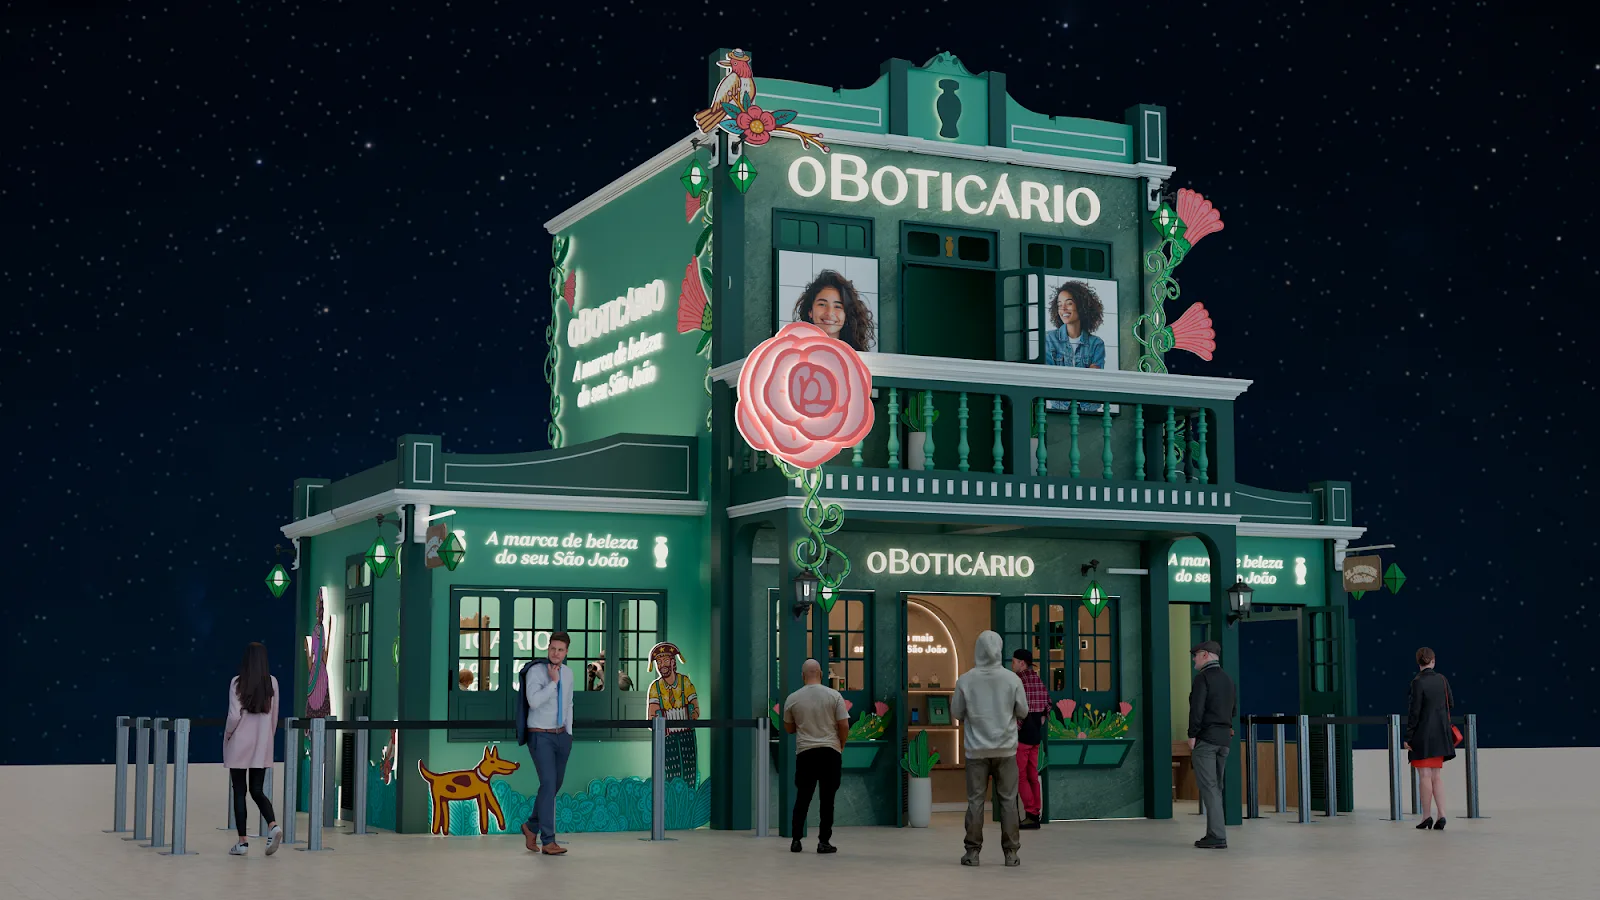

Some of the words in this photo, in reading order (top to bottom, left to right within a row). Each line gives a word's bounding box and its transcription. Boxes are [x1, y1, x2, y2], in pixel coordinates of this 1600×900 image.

[572, 360, 583, 383] A
[614, 341, 628, 366] de
[485, 530, 498, 546] A
[503, 534, 559, 548] marca
[562, 532, 582, 548] de
[585, 533, 639, 550] beleza
[495, 549, 517, 565] do
[520, 553, 550, 566] seu
[552, 551, 585, 567] São
[587, 552, 629, 568] João
[1168, 553, 1179, 566] A
[1243, 554, 1284, 569] beleza
[1175, 568, 1193, 583] do
[1245, 571, 1277, 585] João
[912, 633, 934, 643] mais
[925, 644, 948, 654] João
